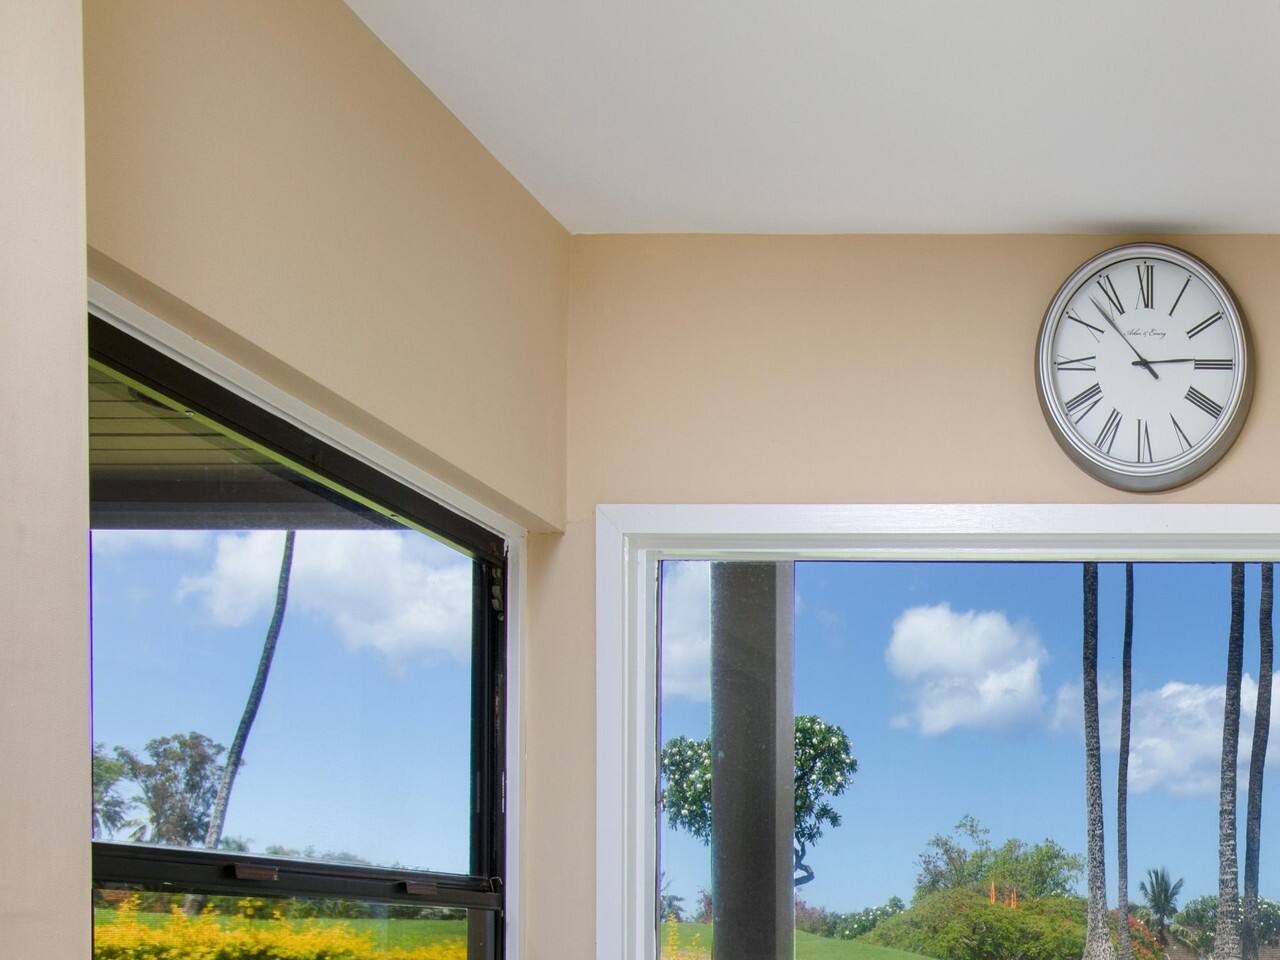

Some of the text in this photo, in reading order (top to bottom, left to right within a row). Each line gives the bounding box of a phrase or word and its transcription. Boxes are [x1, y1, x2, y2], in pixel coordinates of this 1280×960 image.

[1096, 273, 1126, 321] XI
[1135, 264, 1156, 310] XII
[1067, 307, 1105, 343] X
[1185, 311, 1224, 339] II
[1056, 353, 1097, 371] IX
[1193, 359, 1234, 371] III
[1064, 382, 1105, 425] VIII
[1184, 385, 1224, 420] IIII
[1094, 408, 1123, 455] VII
[1136, 418, 1154, 464] VI
[1168, 412, 1193, 453] V
